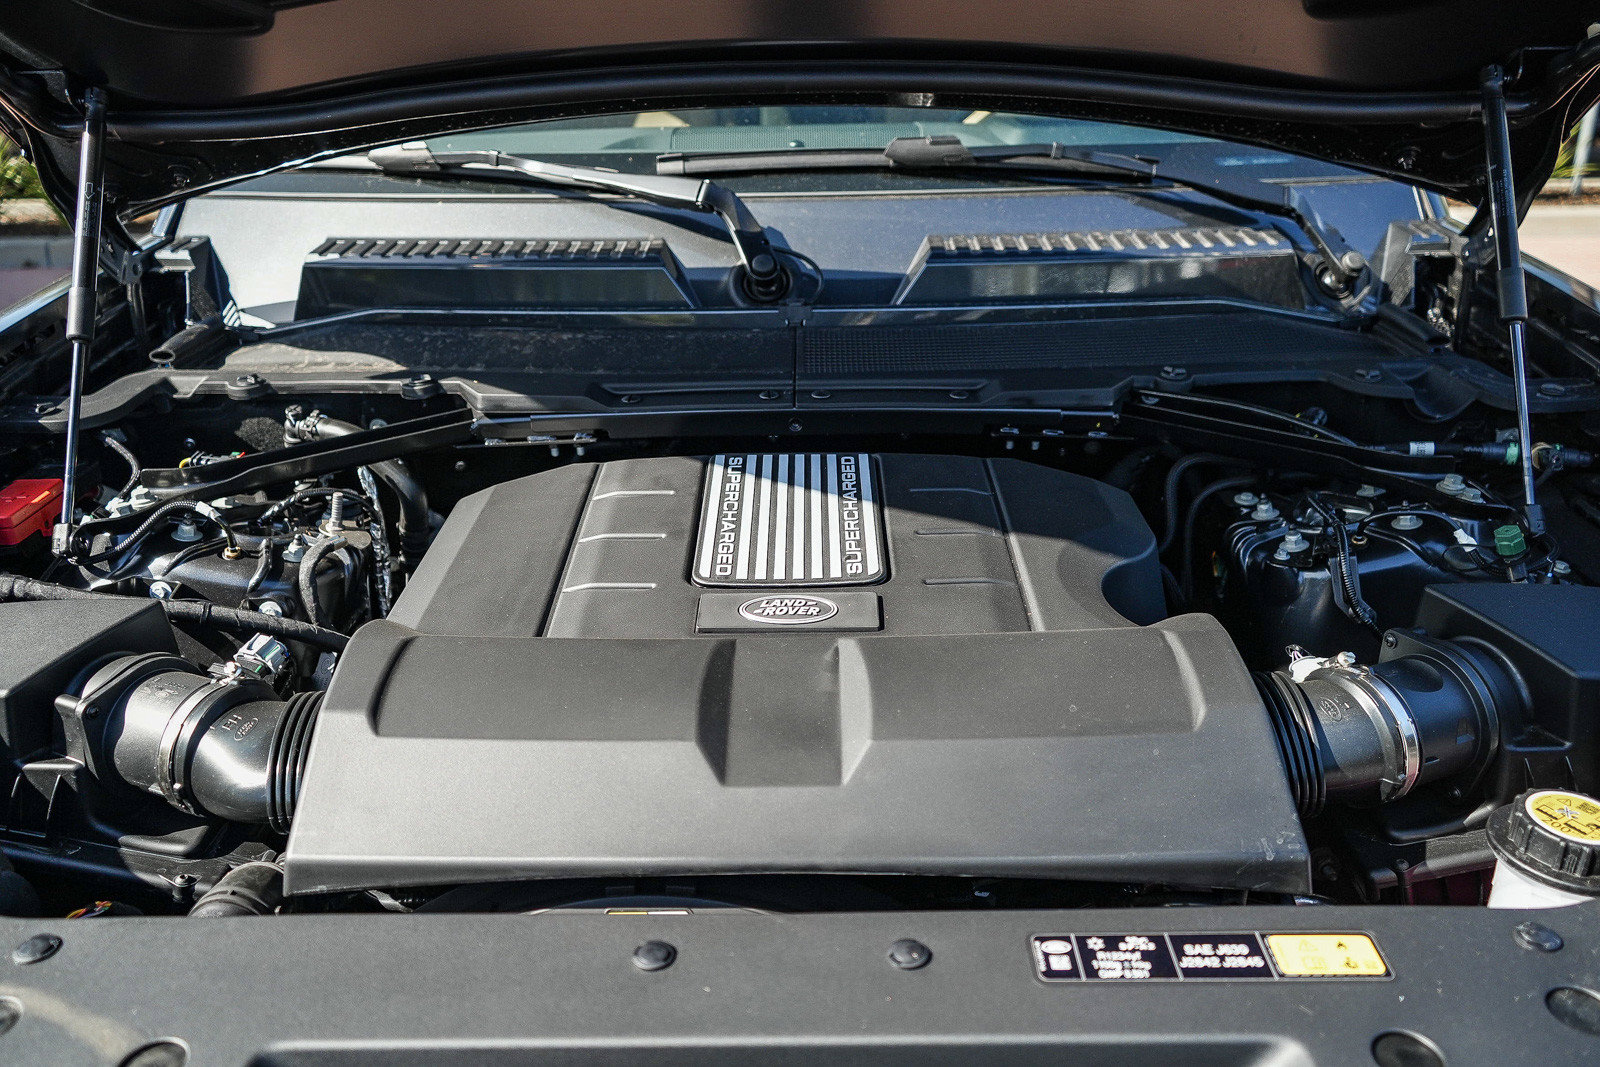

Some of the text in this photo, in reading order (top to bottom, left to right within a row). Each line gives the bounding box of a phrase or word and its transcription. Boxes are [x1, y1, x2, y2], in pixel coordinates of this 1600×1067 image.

[715, 456, 743, 576] SUPERCHARGED
[840, 456, 863, 575] SUPERCHARGED
[762, 607, 820, 616] ROVER
